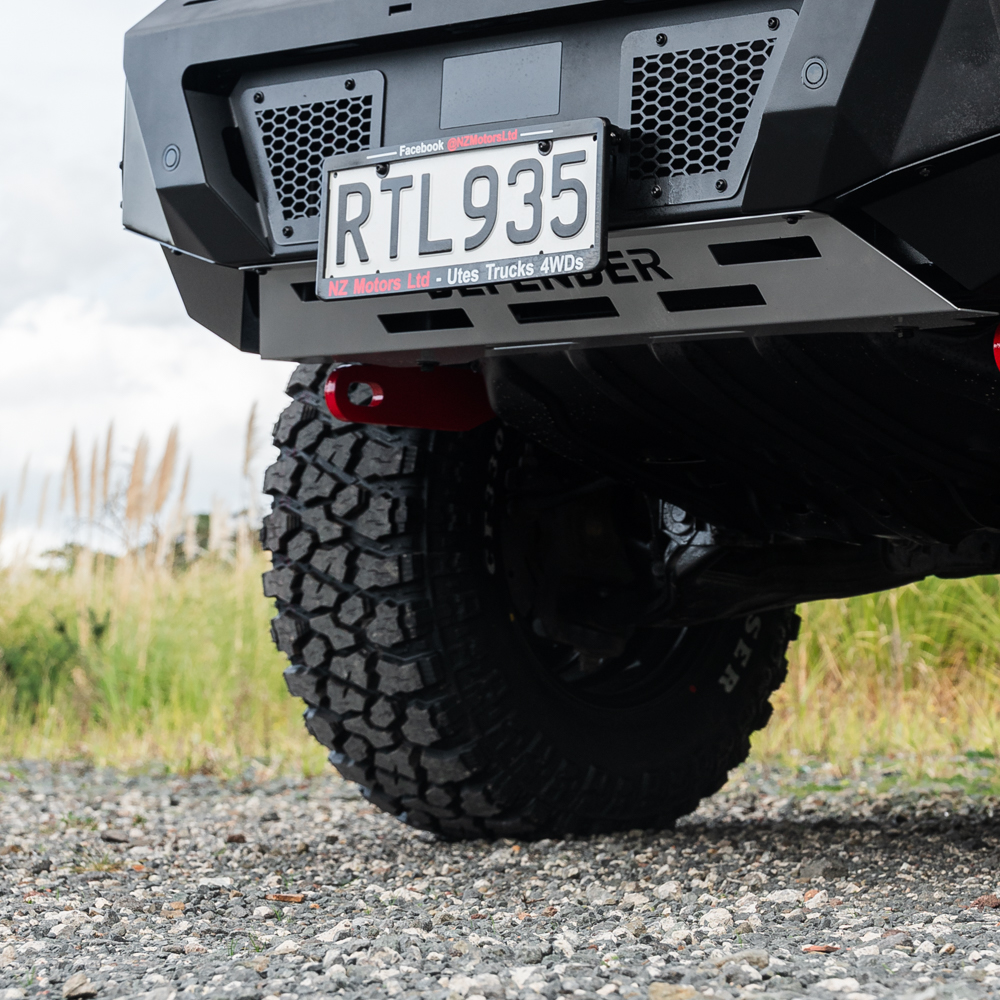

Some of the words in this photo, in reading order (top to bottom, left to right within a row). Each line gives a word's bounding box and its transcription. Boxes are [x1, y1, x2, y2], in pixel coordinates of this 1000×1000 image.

[399, 139, 445, 156] Facebook
[446, 128, 518, 152] @NZMotorsLtd
[335, 149, 588, 266] RTL935
[328, 279, 349, 297] NZ
[353, 277, 402, 295] Motors
[407, 270, 431, 289] Ltd
[447, 267, 480, 285] Utes
[485, 260, 535, 281] Trucks
[540, 254, 584, 274] 4WDs
